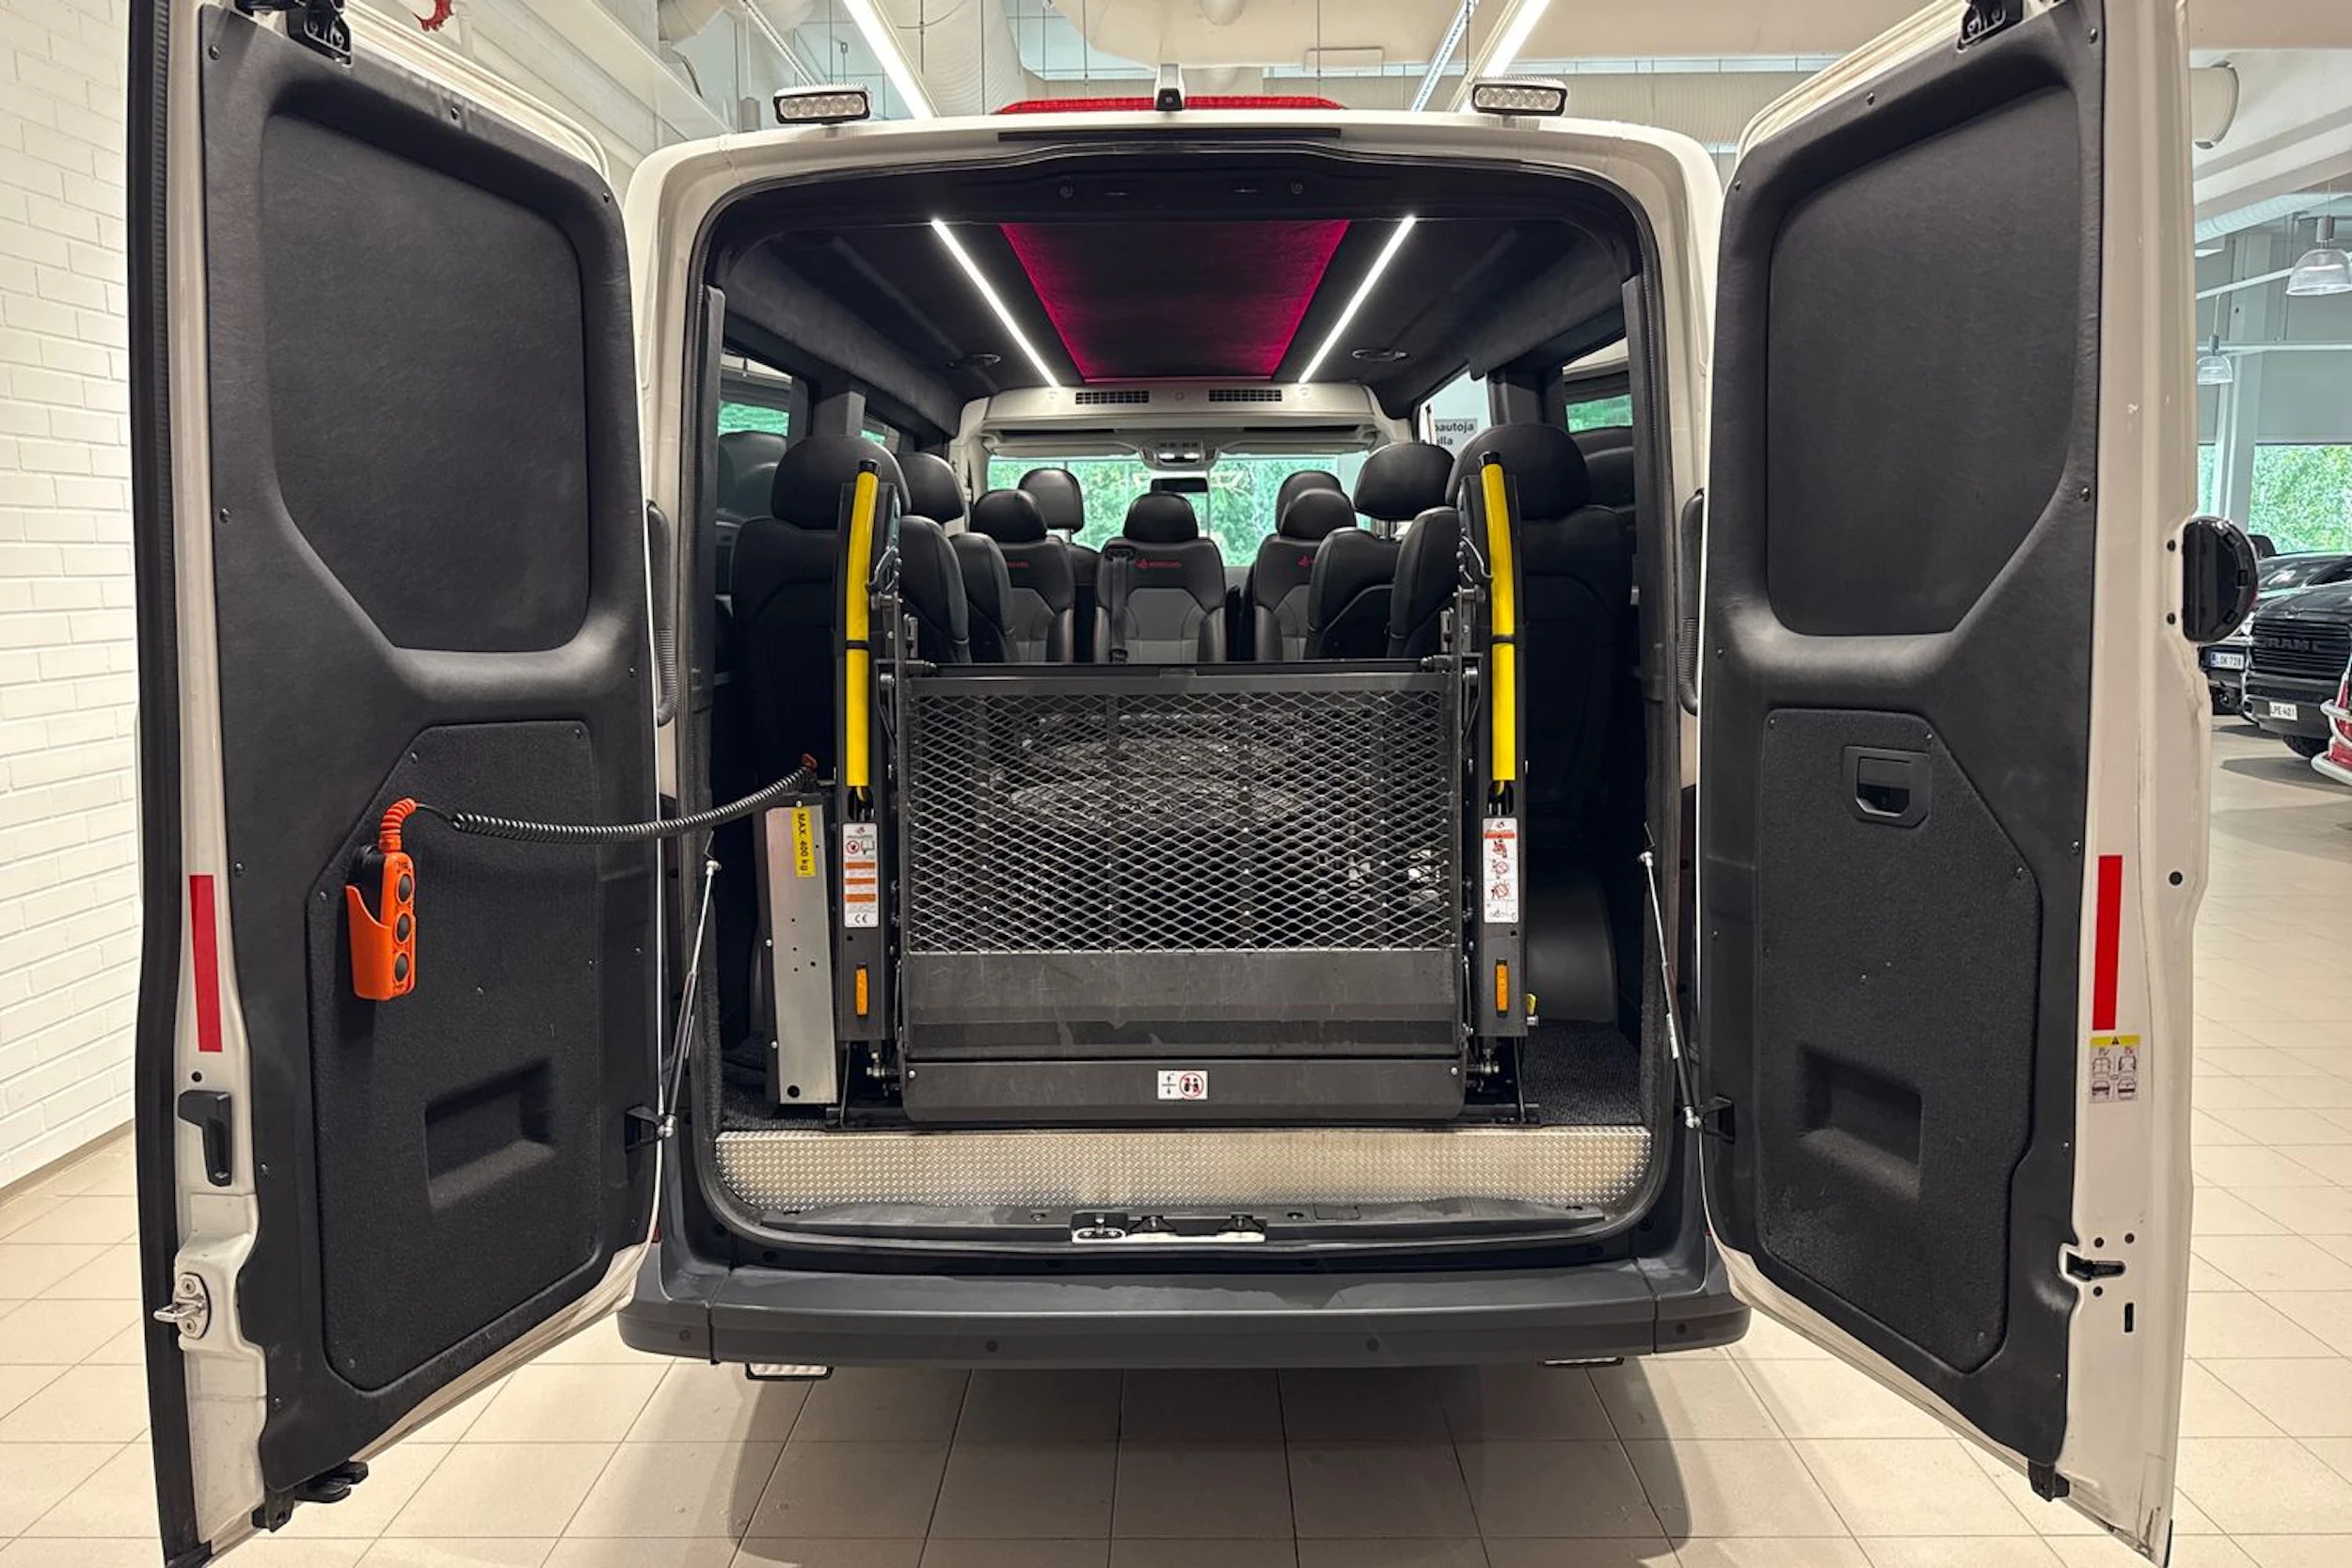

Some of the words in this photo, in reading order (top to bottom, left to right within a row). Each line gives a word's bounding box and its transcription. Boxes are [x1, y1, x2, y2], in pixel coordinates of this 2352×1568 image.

[800, 840, 809, 857] 400
[800, 859, 810, 871] kg
[854, 913, 867, 924] CE
